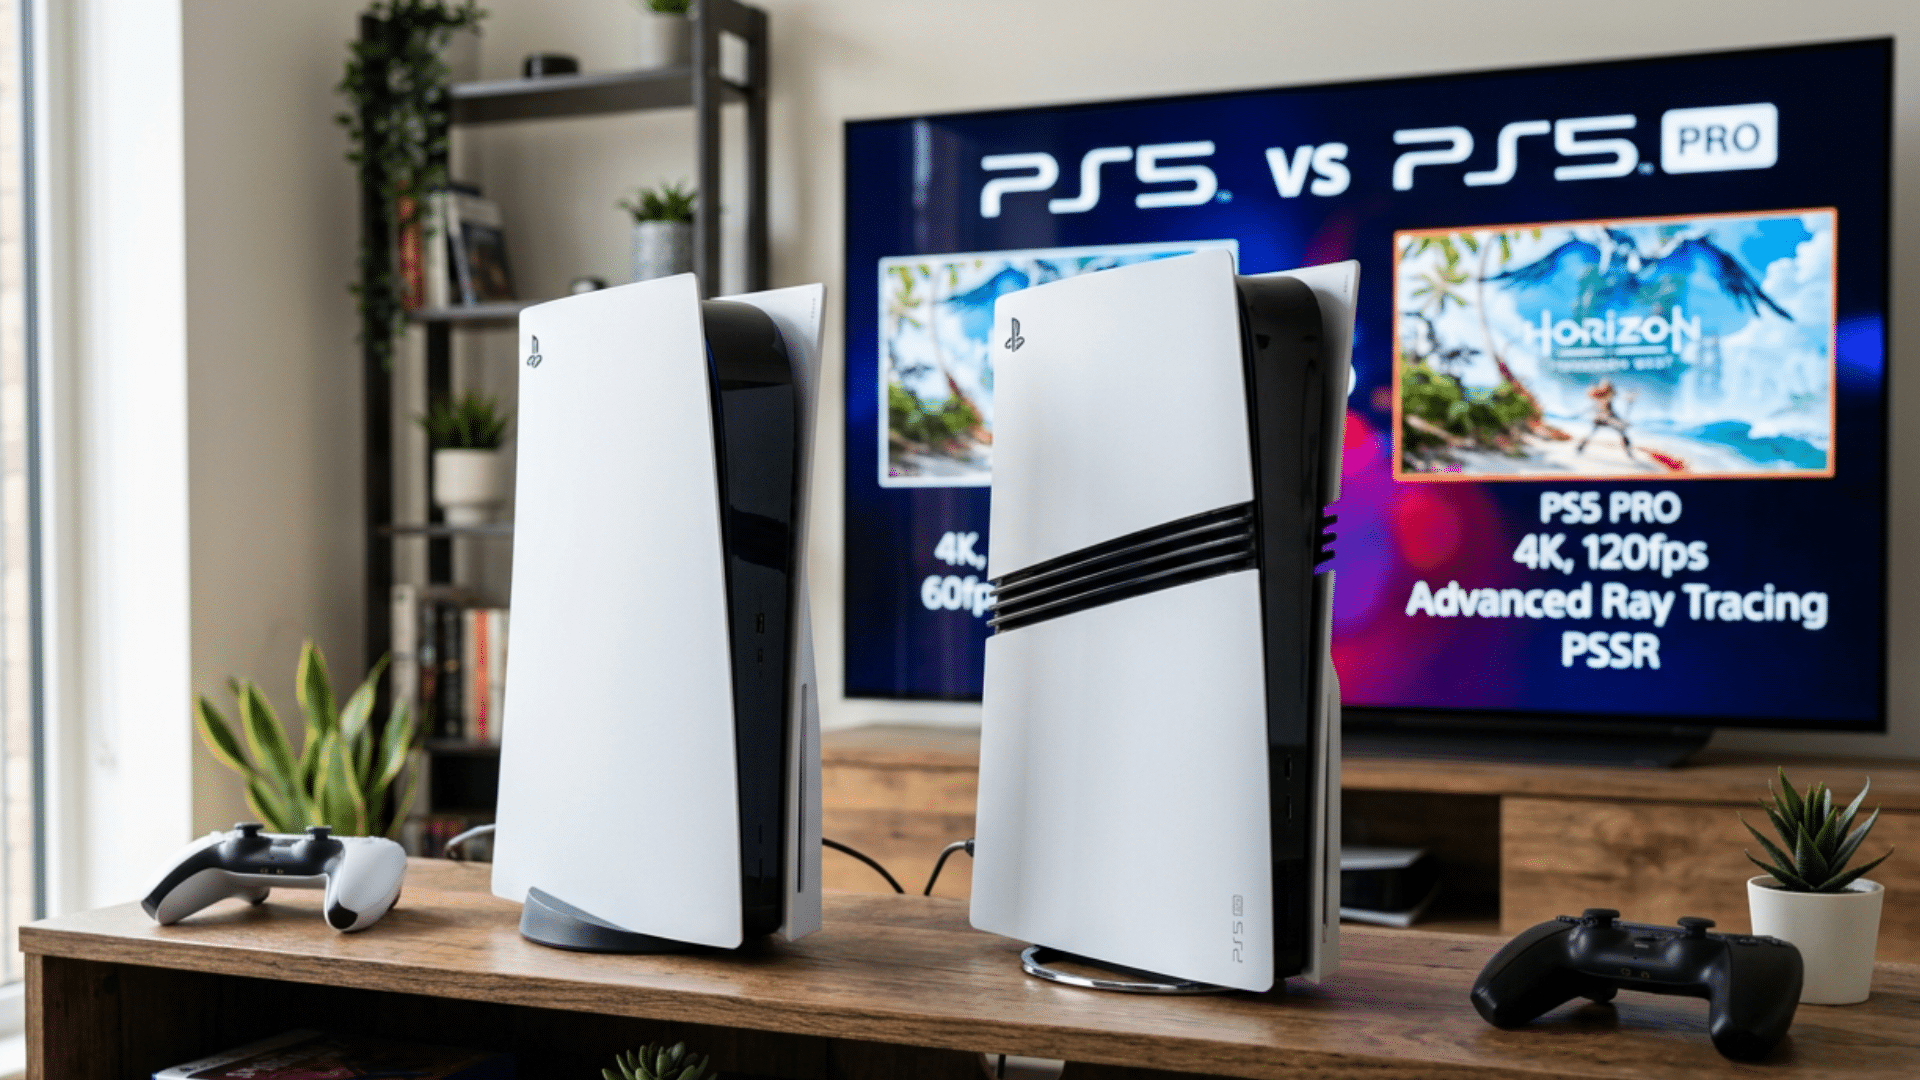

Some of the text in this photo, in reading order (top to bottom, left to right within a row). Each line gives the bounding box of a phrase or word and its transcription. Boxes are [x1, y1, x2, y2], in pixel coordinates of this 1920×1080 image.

[980, 140, 1218, 218] PS5
[1393, 114, 1640, 191] PS5
[1677, 121, 1762, 158] PRO
[1522, 304, 1702, 357] HORIZON
[1539, 490, 1683, 524] PS5 PRO
[934, 531, 988, 571] 4K,
[1512, 533, 1710, 578] 4K, 120fps
[920, 574, 998, 618] 60fp
[1404, 579, 1829, 630] Advanced Ray Tracing
[1561, 630, 1662, 670] PSSR
